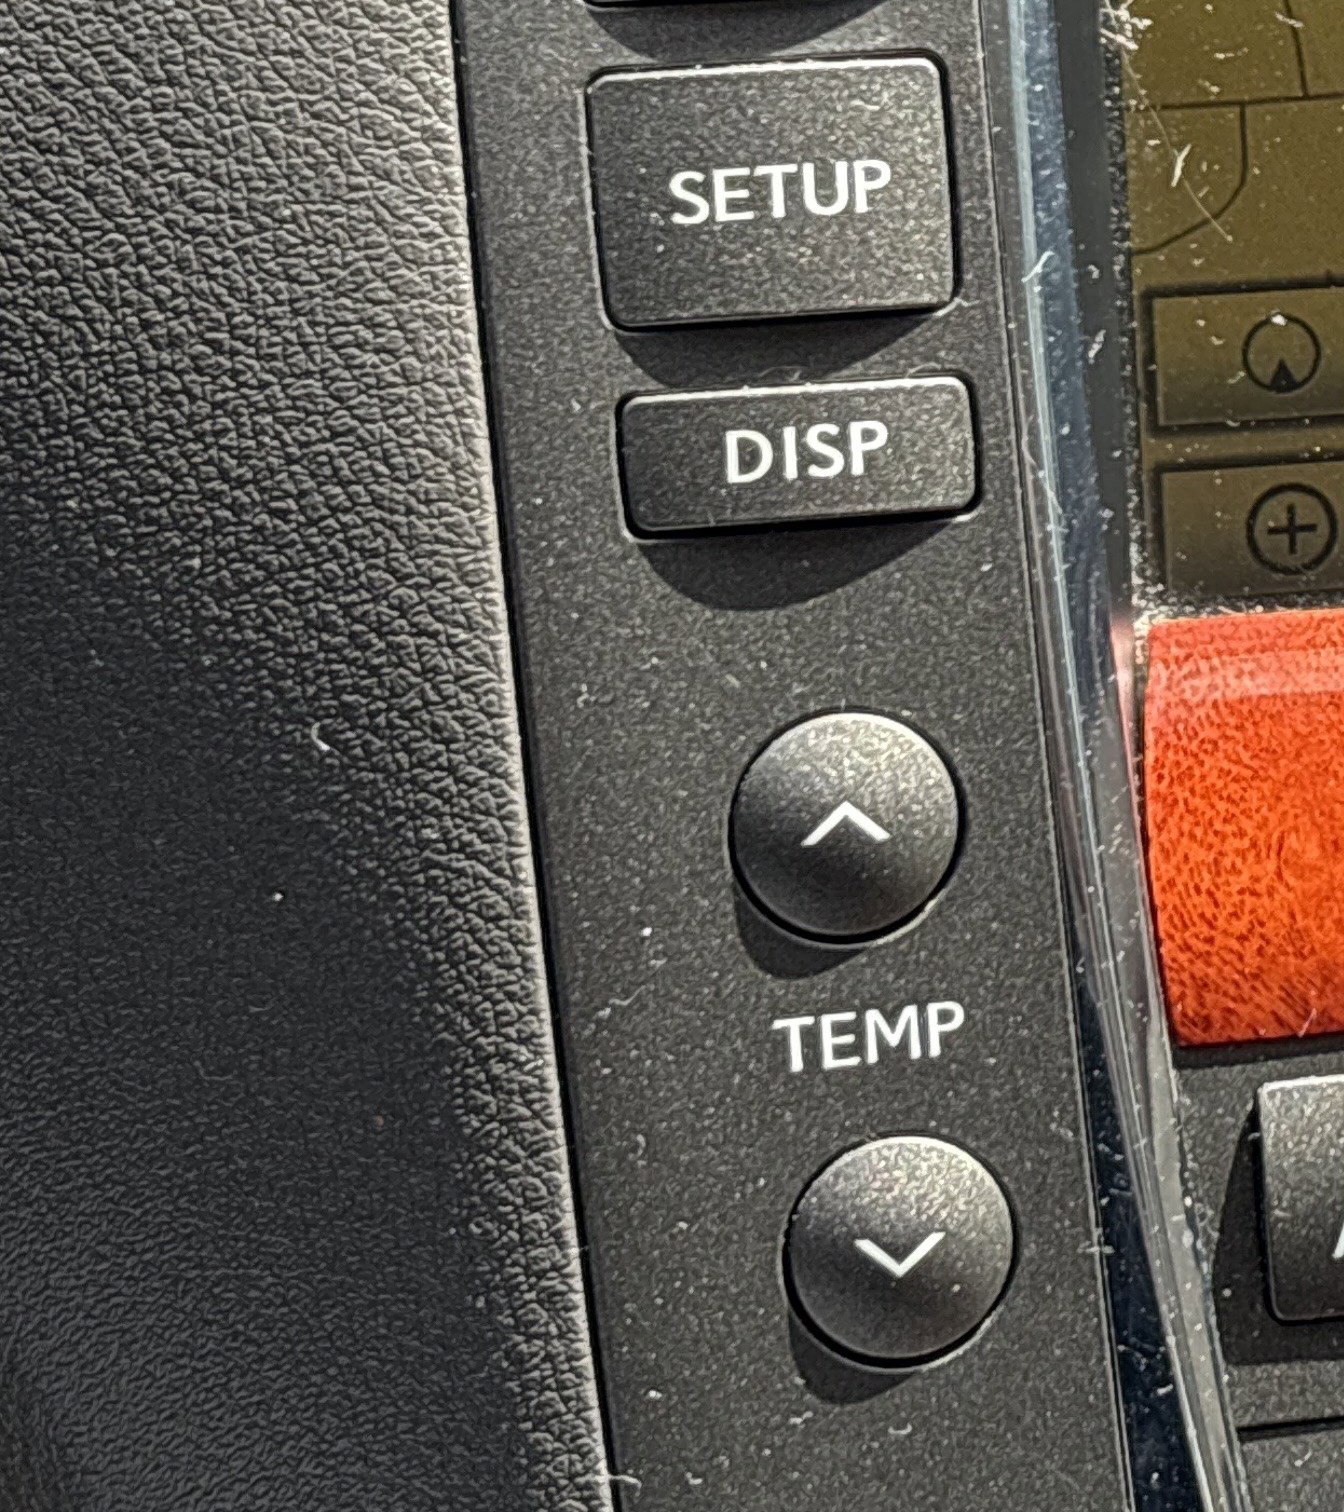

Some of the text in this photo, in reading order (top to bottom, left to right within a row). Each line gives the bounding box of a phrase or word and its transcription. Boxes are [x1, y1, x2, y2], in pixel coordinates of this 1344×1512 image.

[669, 160, 891, 225] SETUP
[725, 420, 888, 484] DISP
[772, 1001, 964, 1073] TEMP
